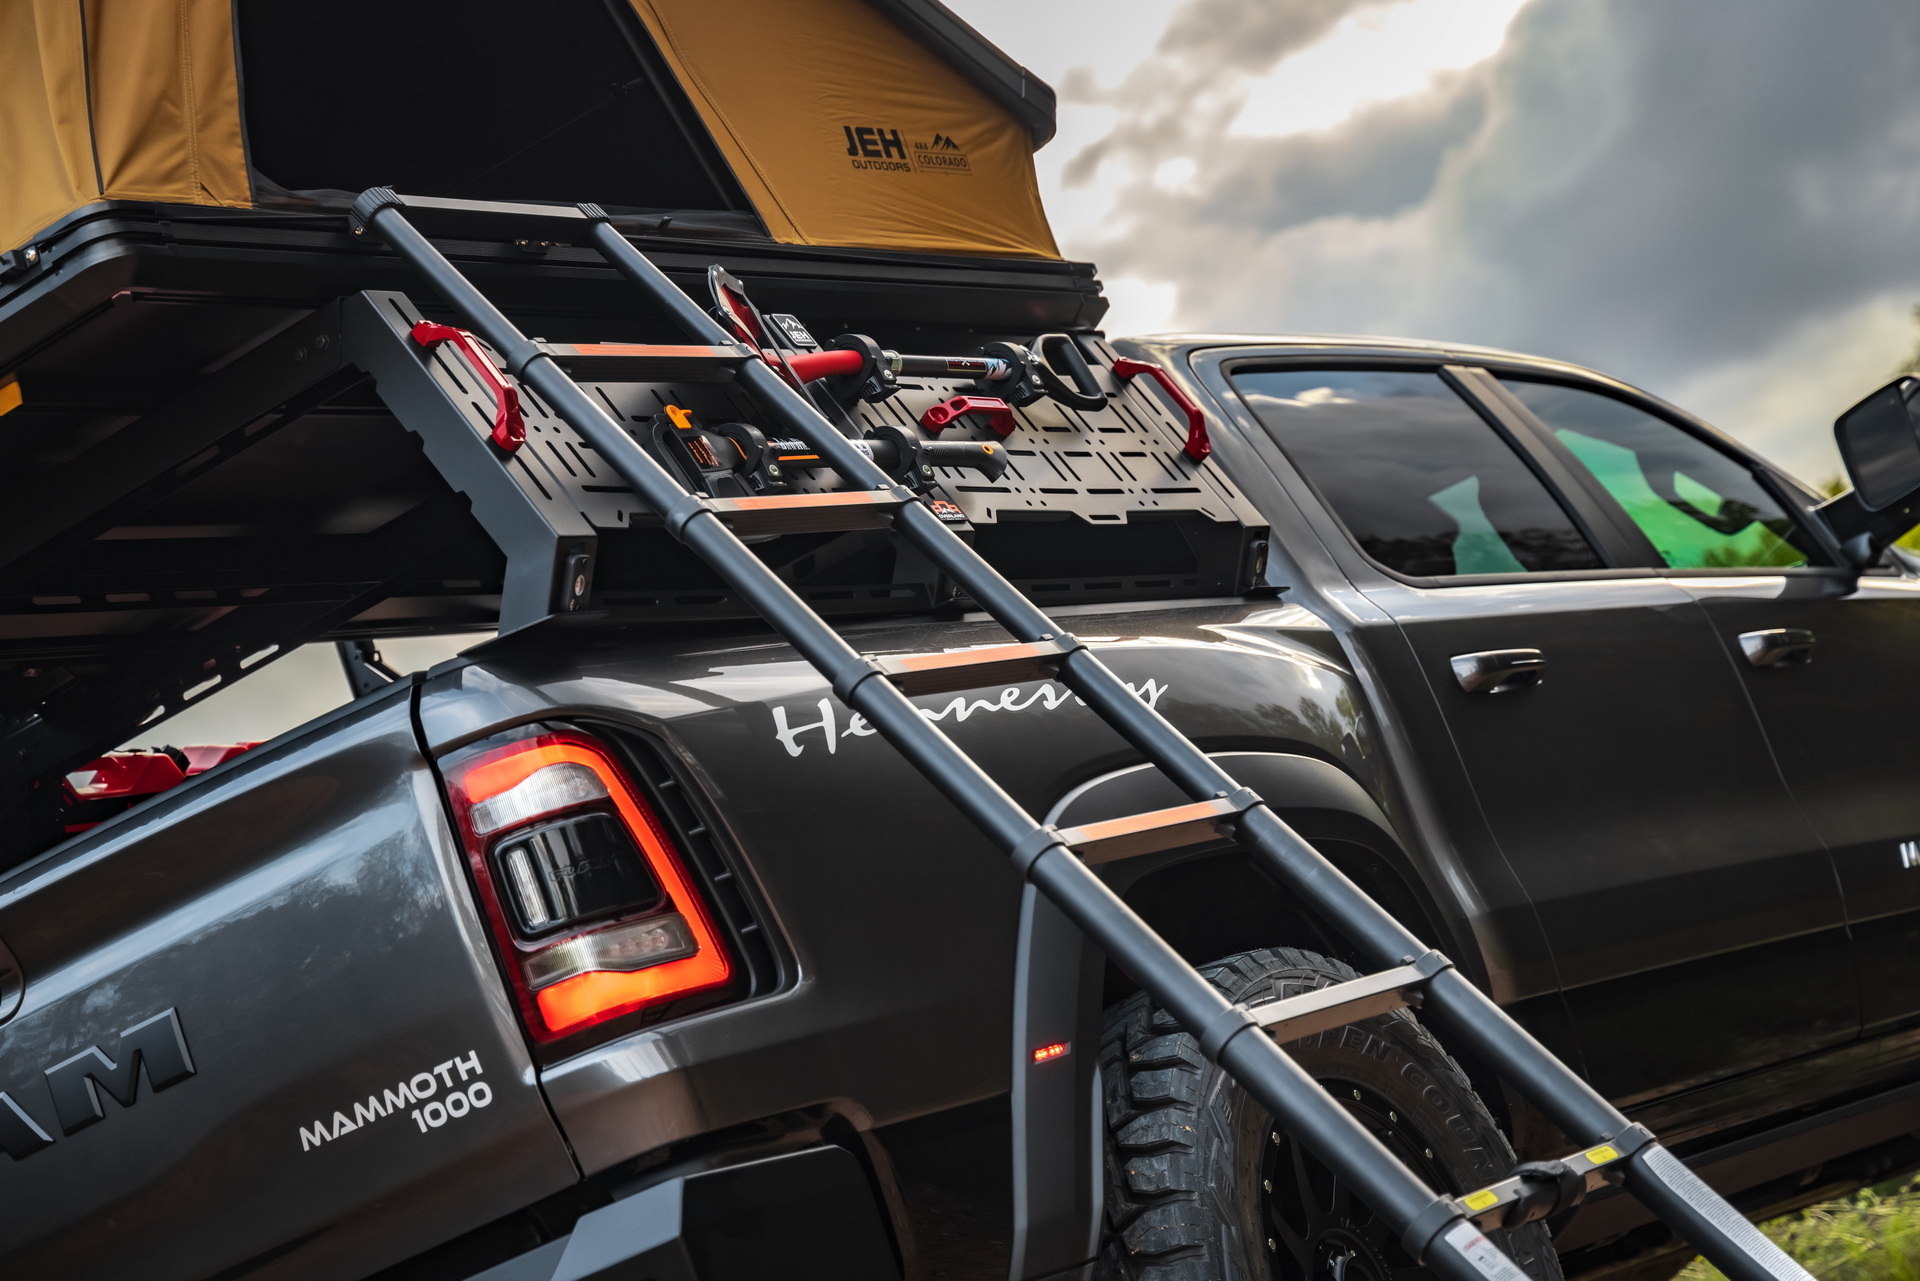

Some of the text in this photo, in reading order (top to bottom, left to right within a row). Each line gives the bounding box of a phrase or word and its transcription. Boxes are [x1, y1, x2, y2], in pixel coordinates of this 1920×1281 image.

[843, 125, 907, 160] JEH
[851, 159, 911, 173] OUTDOORS
[916, 154, 968, 169] COLORADO
[299, 1050, 484, 1152] MAMMOTH
[411, 1081, 494, 1134] 1000
